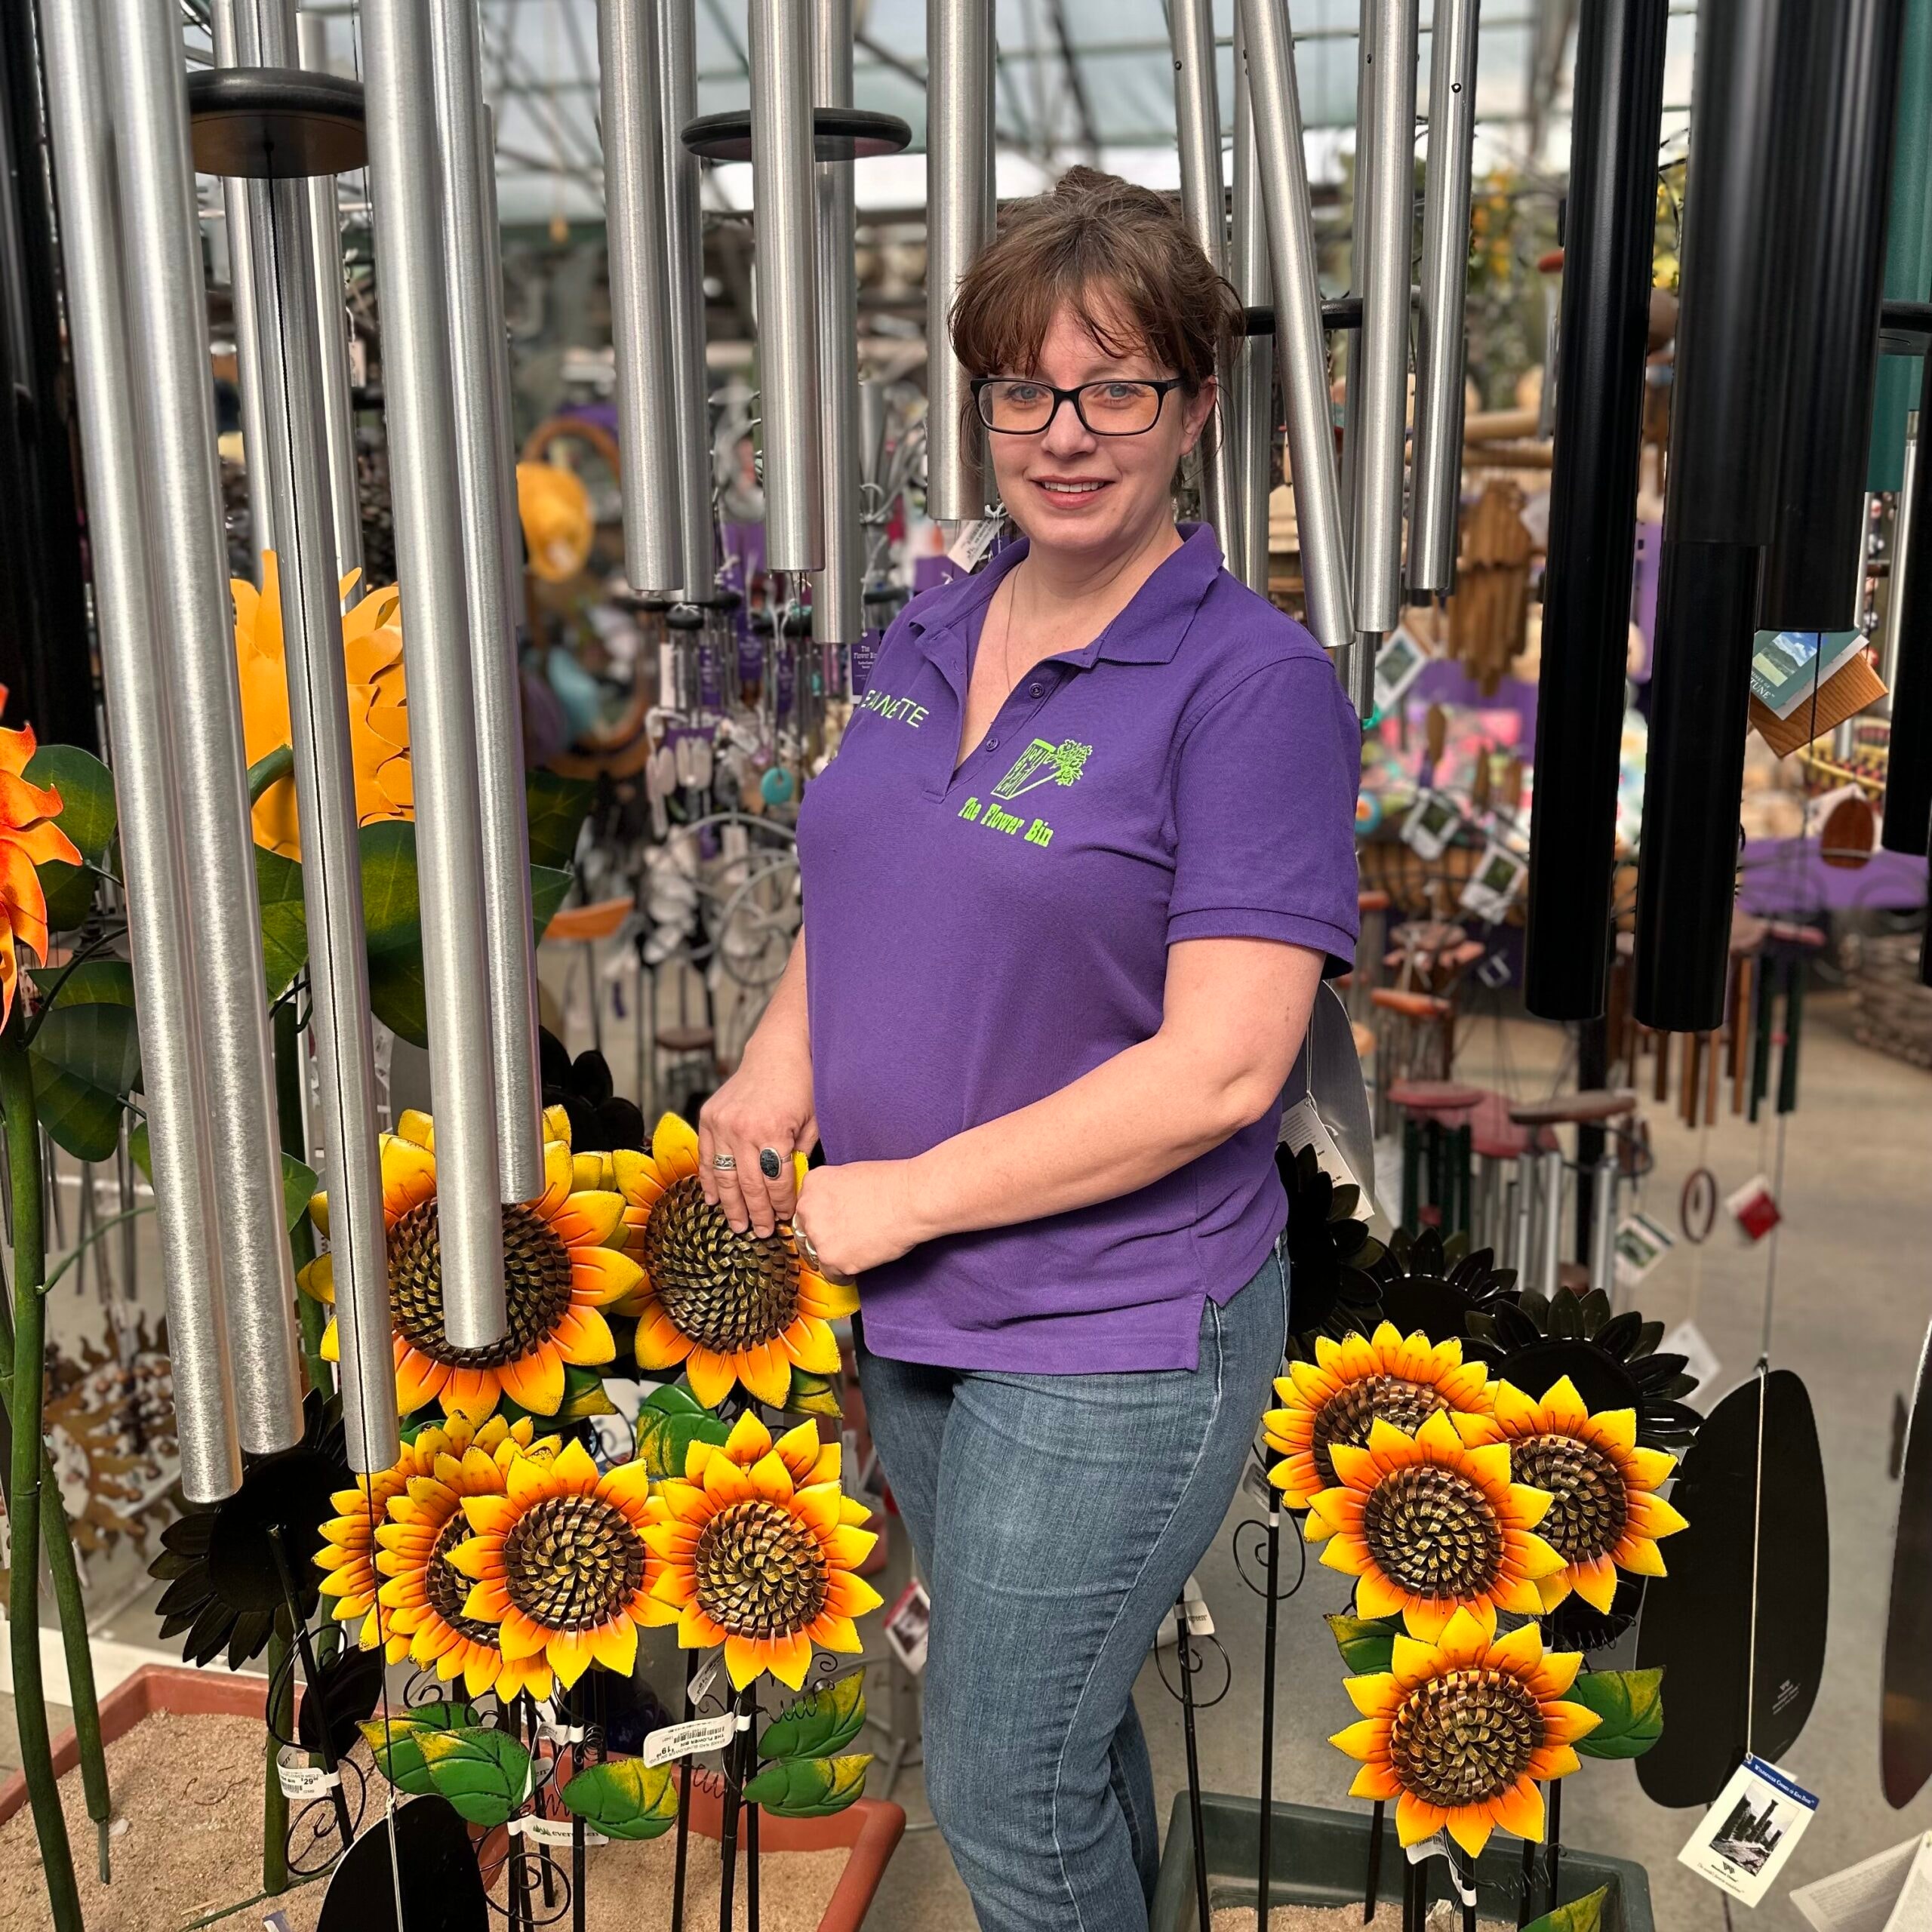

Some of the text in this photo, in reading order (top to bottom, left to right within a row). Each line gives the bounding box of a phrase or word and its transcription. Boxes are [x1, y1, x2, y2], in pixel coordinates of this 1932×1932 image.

[958, 796, 1054, 848] The Flower Bin
